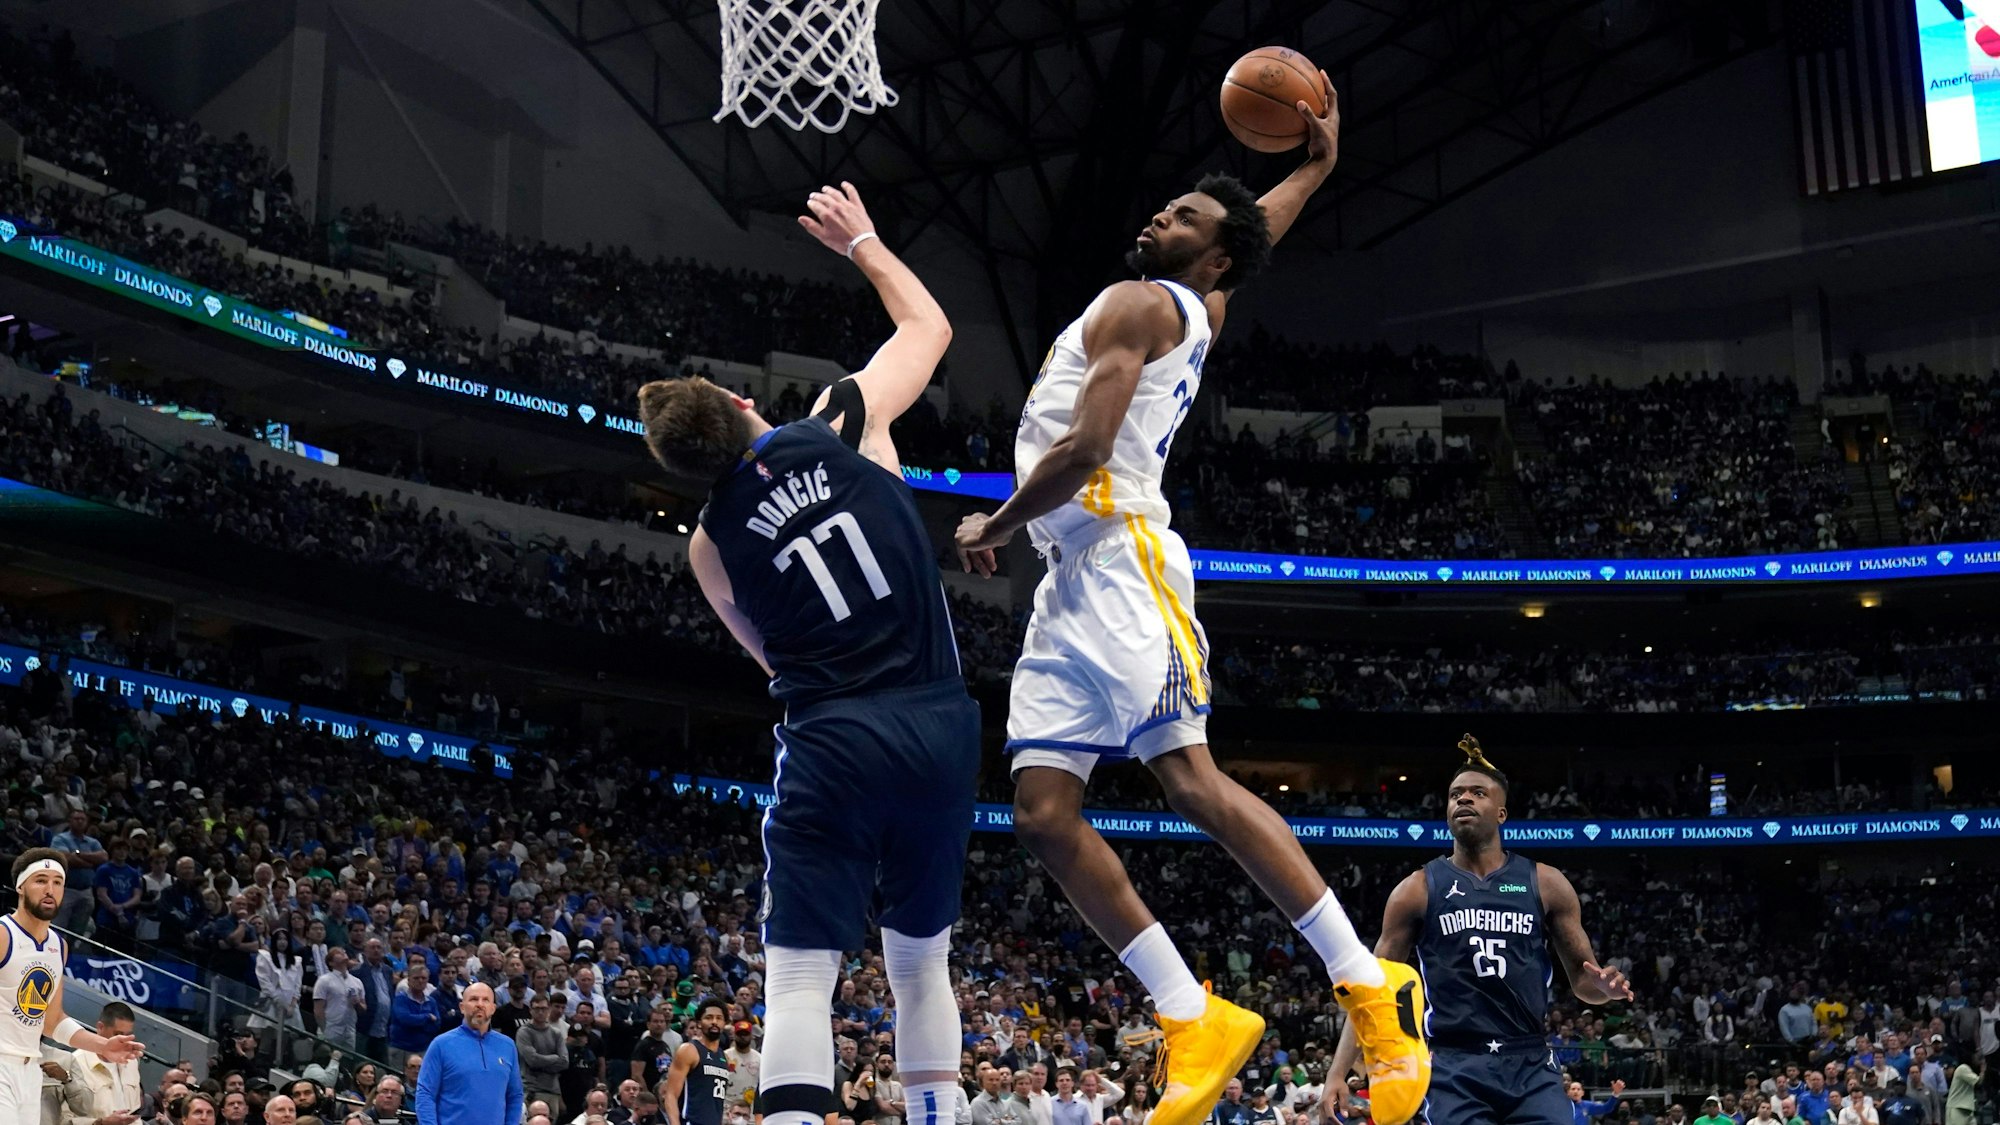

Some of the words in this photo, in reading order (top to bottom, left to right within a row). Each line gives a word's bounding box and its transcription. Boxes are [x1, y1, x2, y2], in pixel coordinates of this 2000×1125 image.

[1930, 70, 1990, 90] American
[29, 236, 107, 276] MARILOFF
[114, 266, 194, 308] DIAMONDS
[231, 309, 299, 346] MARILOFF
[304, 335, 377, 372] DIAMONDS
[416, 368, 489, 398] MARILOFF
[495, 387, 569, 418] DIAMONDS
[605, 413, 647, 436] MARIL
[745, 461, 832, 541] DONČIĆ
[771, 511, 893, 624] 77
[1209, 560, 1273, 574] DIAMONDS
[1303, 566, 1361, 580] MARILOFF
[1365, 568, 1429, 582] DIAMONDS
[1461, 569, 1521, 581] MARILOFF
[1527, 568, 1592, 581] DIAMONDS
[1624, 569, 1684, 580] MARILOFF
[1690, 566, 1756, 580] DIAMONDS
[1791, 560, 1853, 575] MARILOFF
[1859, 555, 1928, 571] DIAMONDS
[332, 722, 400, 749] DIANDS
[432, 742, 470, 762] MARIL
[1091, 818, 1153, 832] MARILOFF
[1291, 825, 1326, 838] ILOFF
[1332, 826, 1400, 839] DIAMONDS
[1503, 828, 1574, 841] DIAMONDS
[1611, 827, 1675, 840] MARILOFF
[1682, 826, 1754, 840] DIAMONDS
[1791, 822, 1859, 837] MARILOFF
[1865, 819, 1941, 834] DIAMONDS
[1499, 884, 1528, 893] chime
[1438, 908, 1535, 936] MAVERICKS
[1469, 936, 1507, 979] 25
[20, 960, 42, 976] GOLDEN
[712, 1078, 727, 1100] 26
